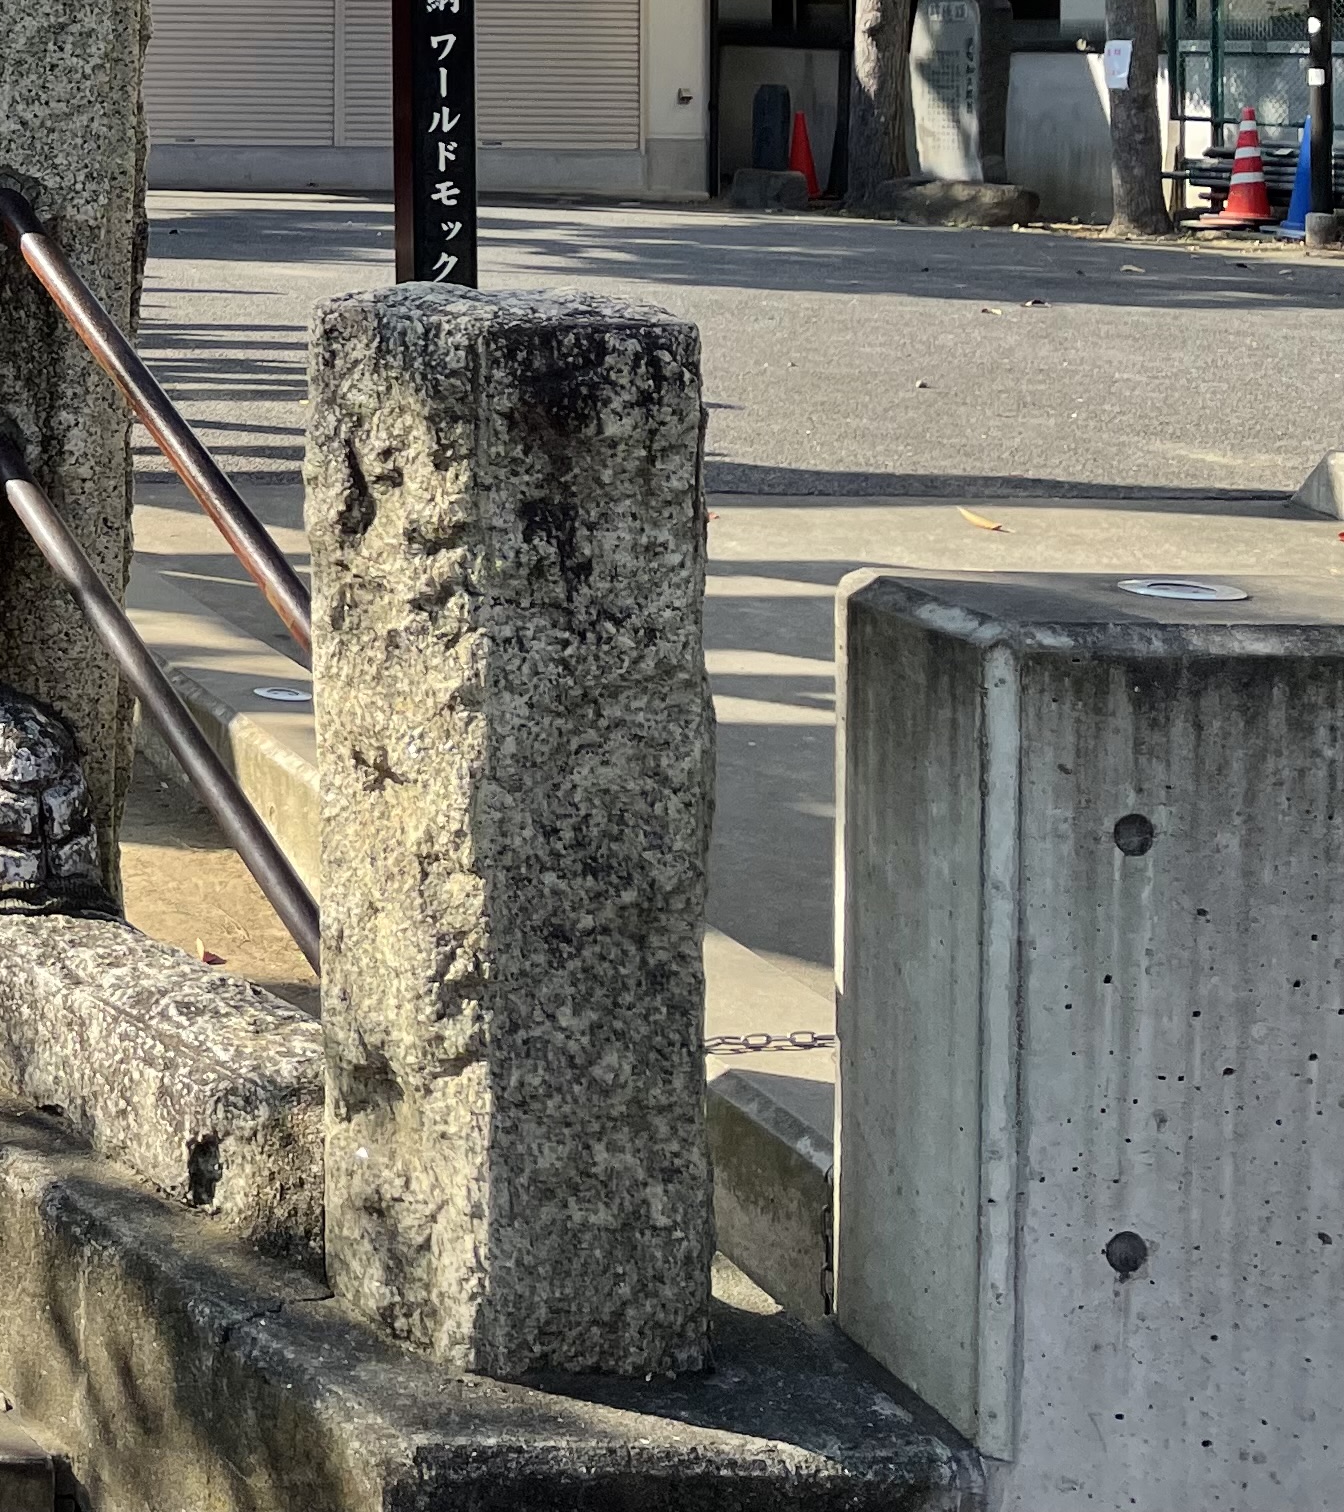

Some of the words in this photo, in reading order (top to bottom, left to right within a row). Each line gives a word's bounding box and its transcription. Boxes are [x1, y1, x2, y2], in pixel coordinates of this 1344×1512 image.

[428, 33, 461, 282] ワールドモック
